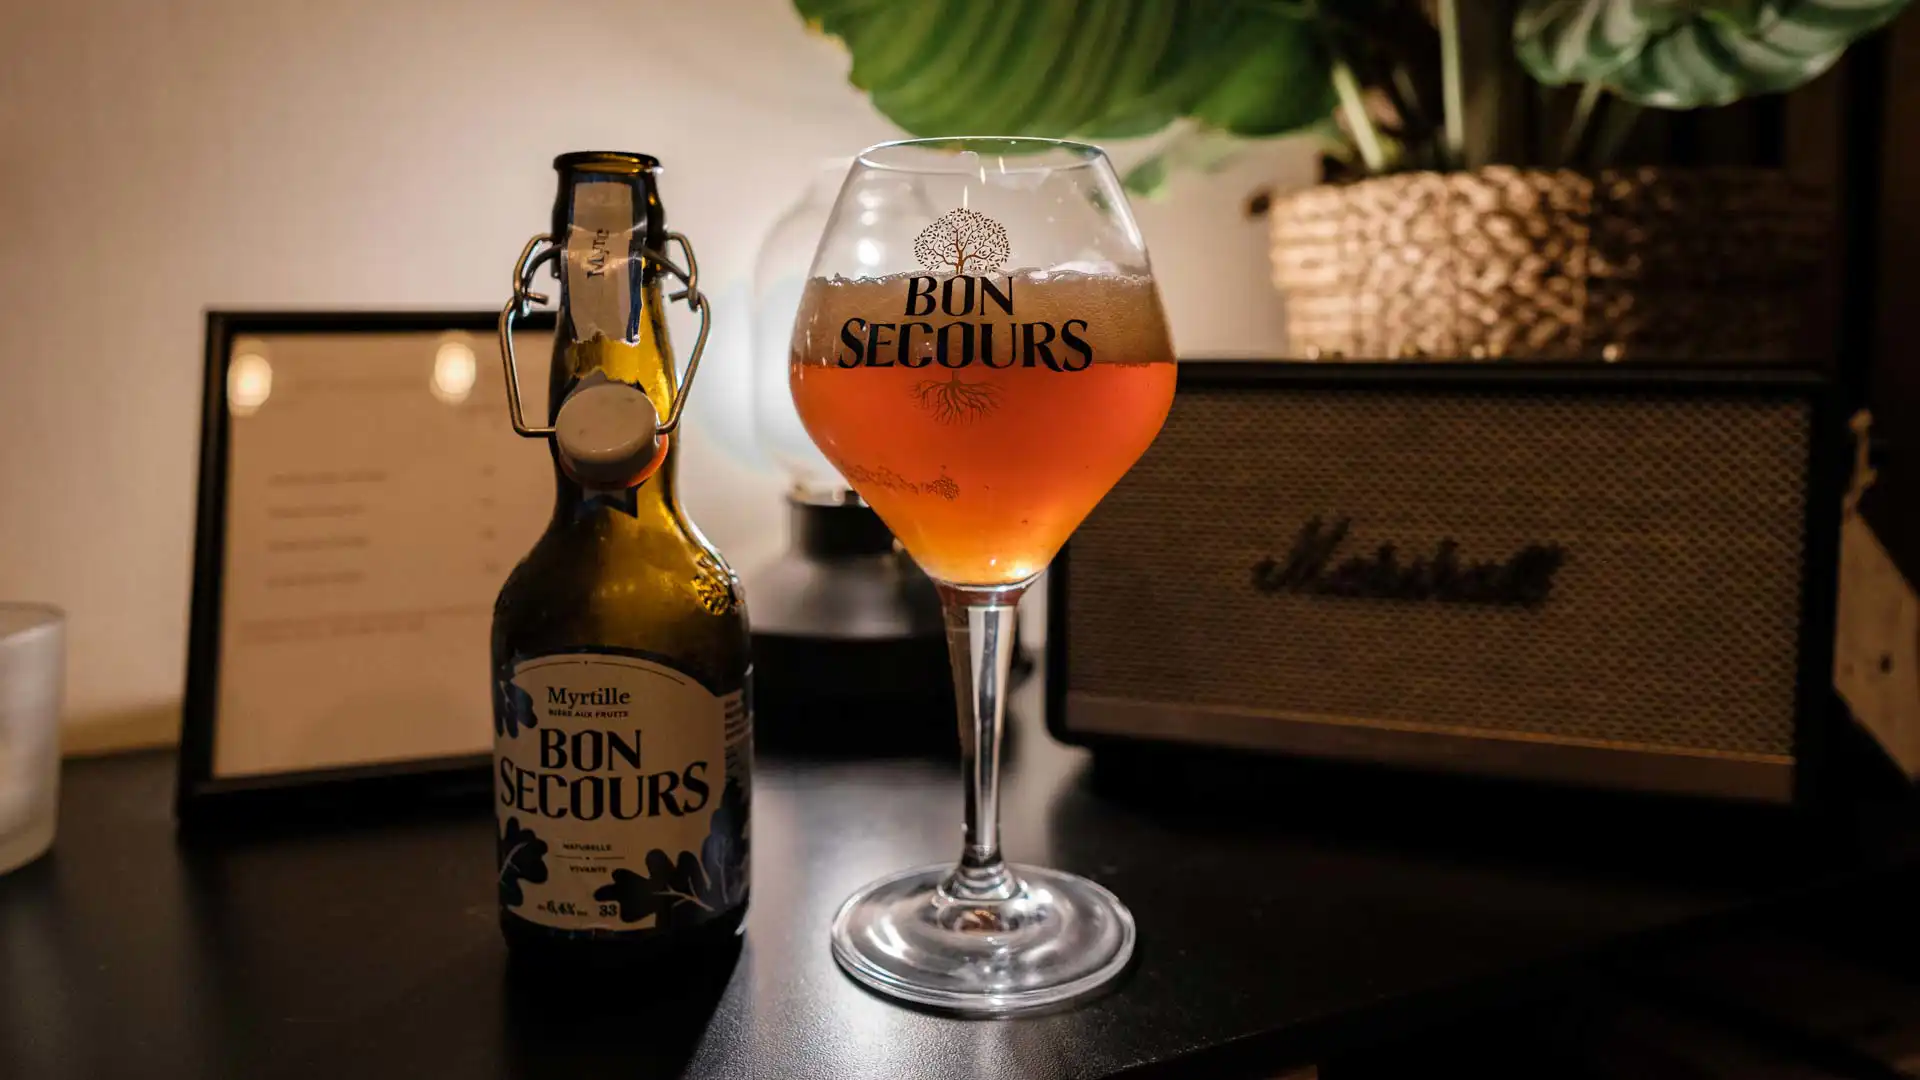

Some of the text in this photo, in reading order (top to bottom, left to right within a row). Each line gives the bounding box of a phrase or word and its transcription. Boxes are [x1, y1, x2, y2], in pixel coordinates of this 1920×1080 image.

[904, 274, 1014, 317] BON
[837, 317, 1093, 373] SECOURS
[547, 687, 631, 710] Myrtille
[574, 711, 593, 719] AUX
[595, 710, 629, 719] FRUITS
[539, 728, 642, 772] BON
[500, 756, 710, 821] SECOURS
